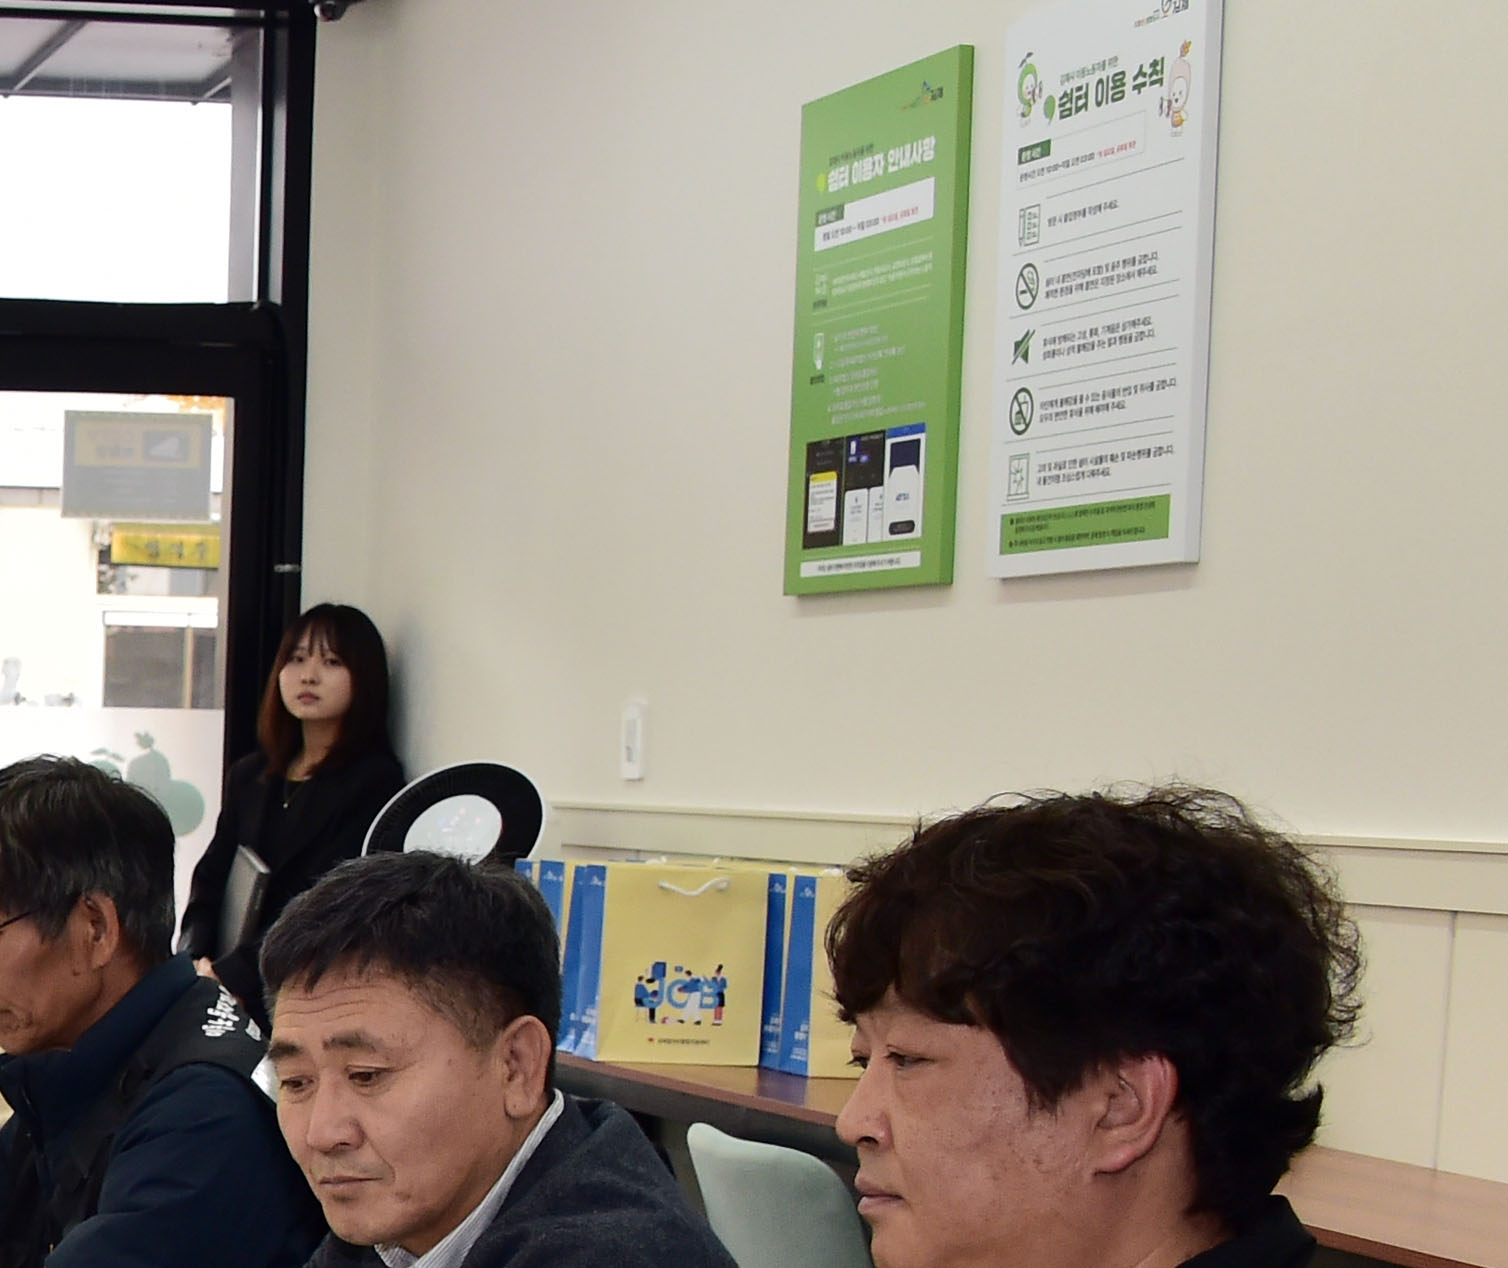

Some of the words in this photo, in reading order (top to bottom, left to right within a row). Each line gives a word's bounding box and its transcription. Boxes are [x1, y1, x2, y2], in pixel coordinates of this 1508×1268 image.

[1058, 83, 1089, 120] 쉼터
[1095, 70, 1126, 108] 이용
[1132, 56, 1165, 95] 수칙
[851, 152, 885, 185] 이용자
[887, 135, 937, 174] 안내사항
